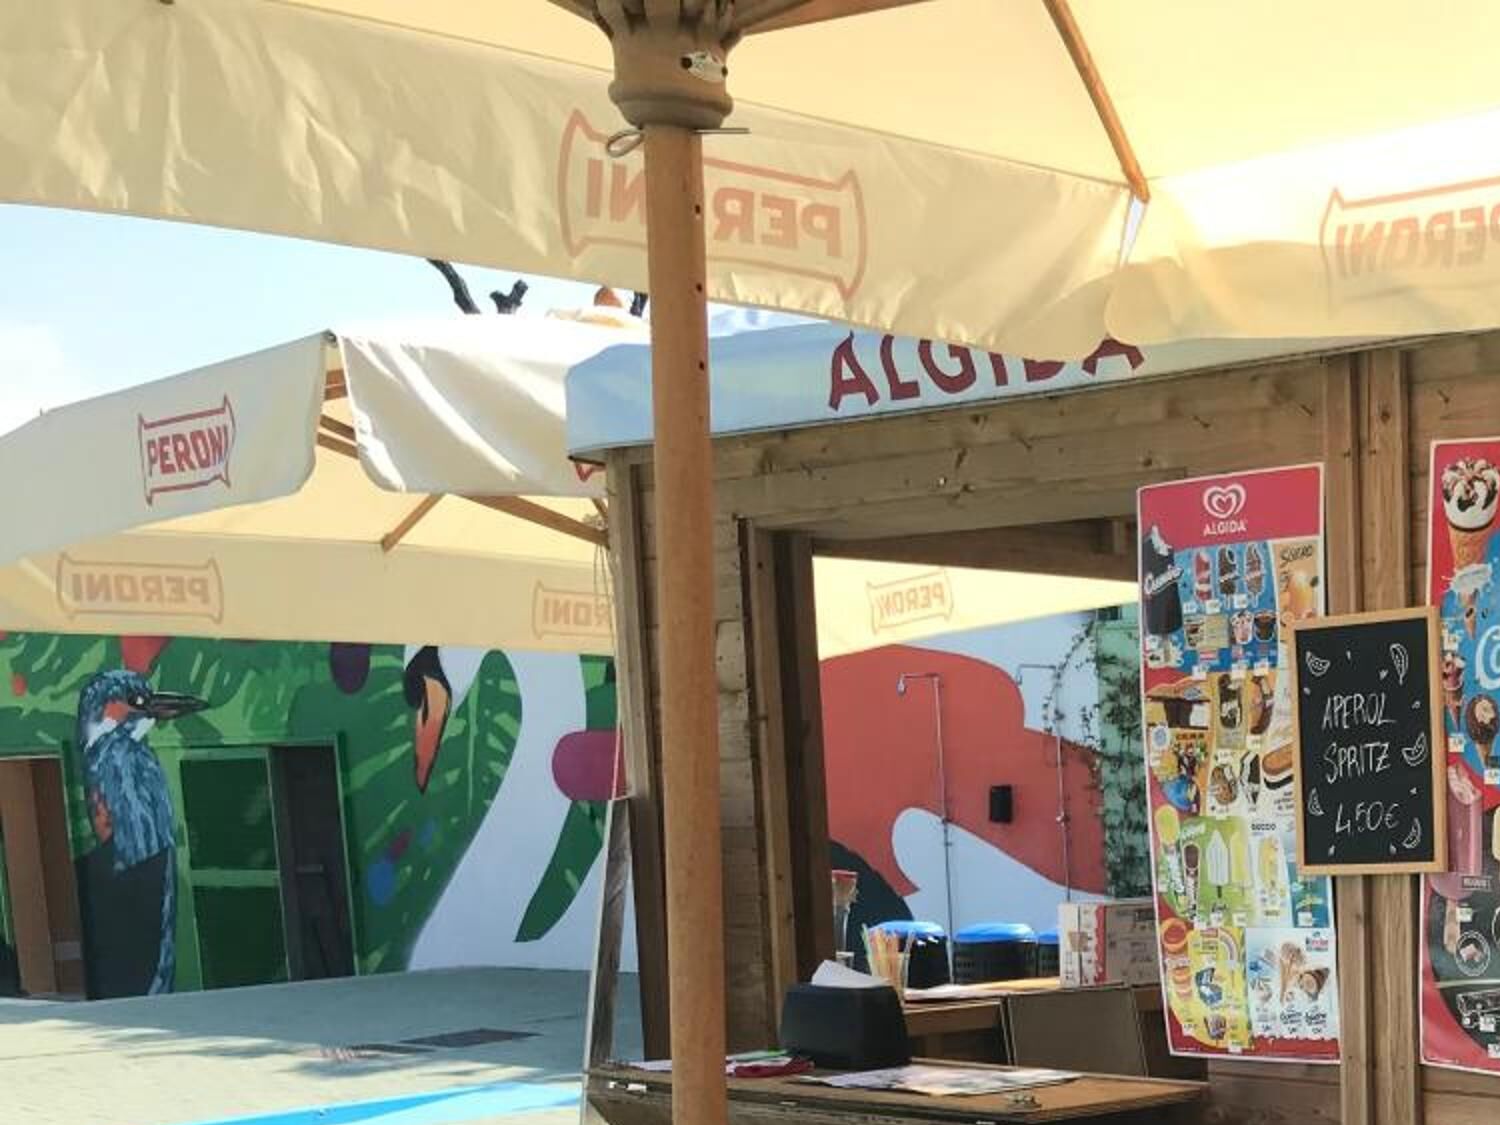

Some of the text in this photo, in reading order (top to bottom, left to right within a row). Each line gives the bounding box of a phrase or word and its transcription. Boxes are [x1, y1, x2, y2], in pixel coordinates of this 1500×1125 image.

[145, 424, 230, 477] PERONI
[1203, 519, 1247, 536] ALGIDA
[1322, 692, 1397, 731] APEROL
[1324, 741, 1392, 784] SPRITZ
